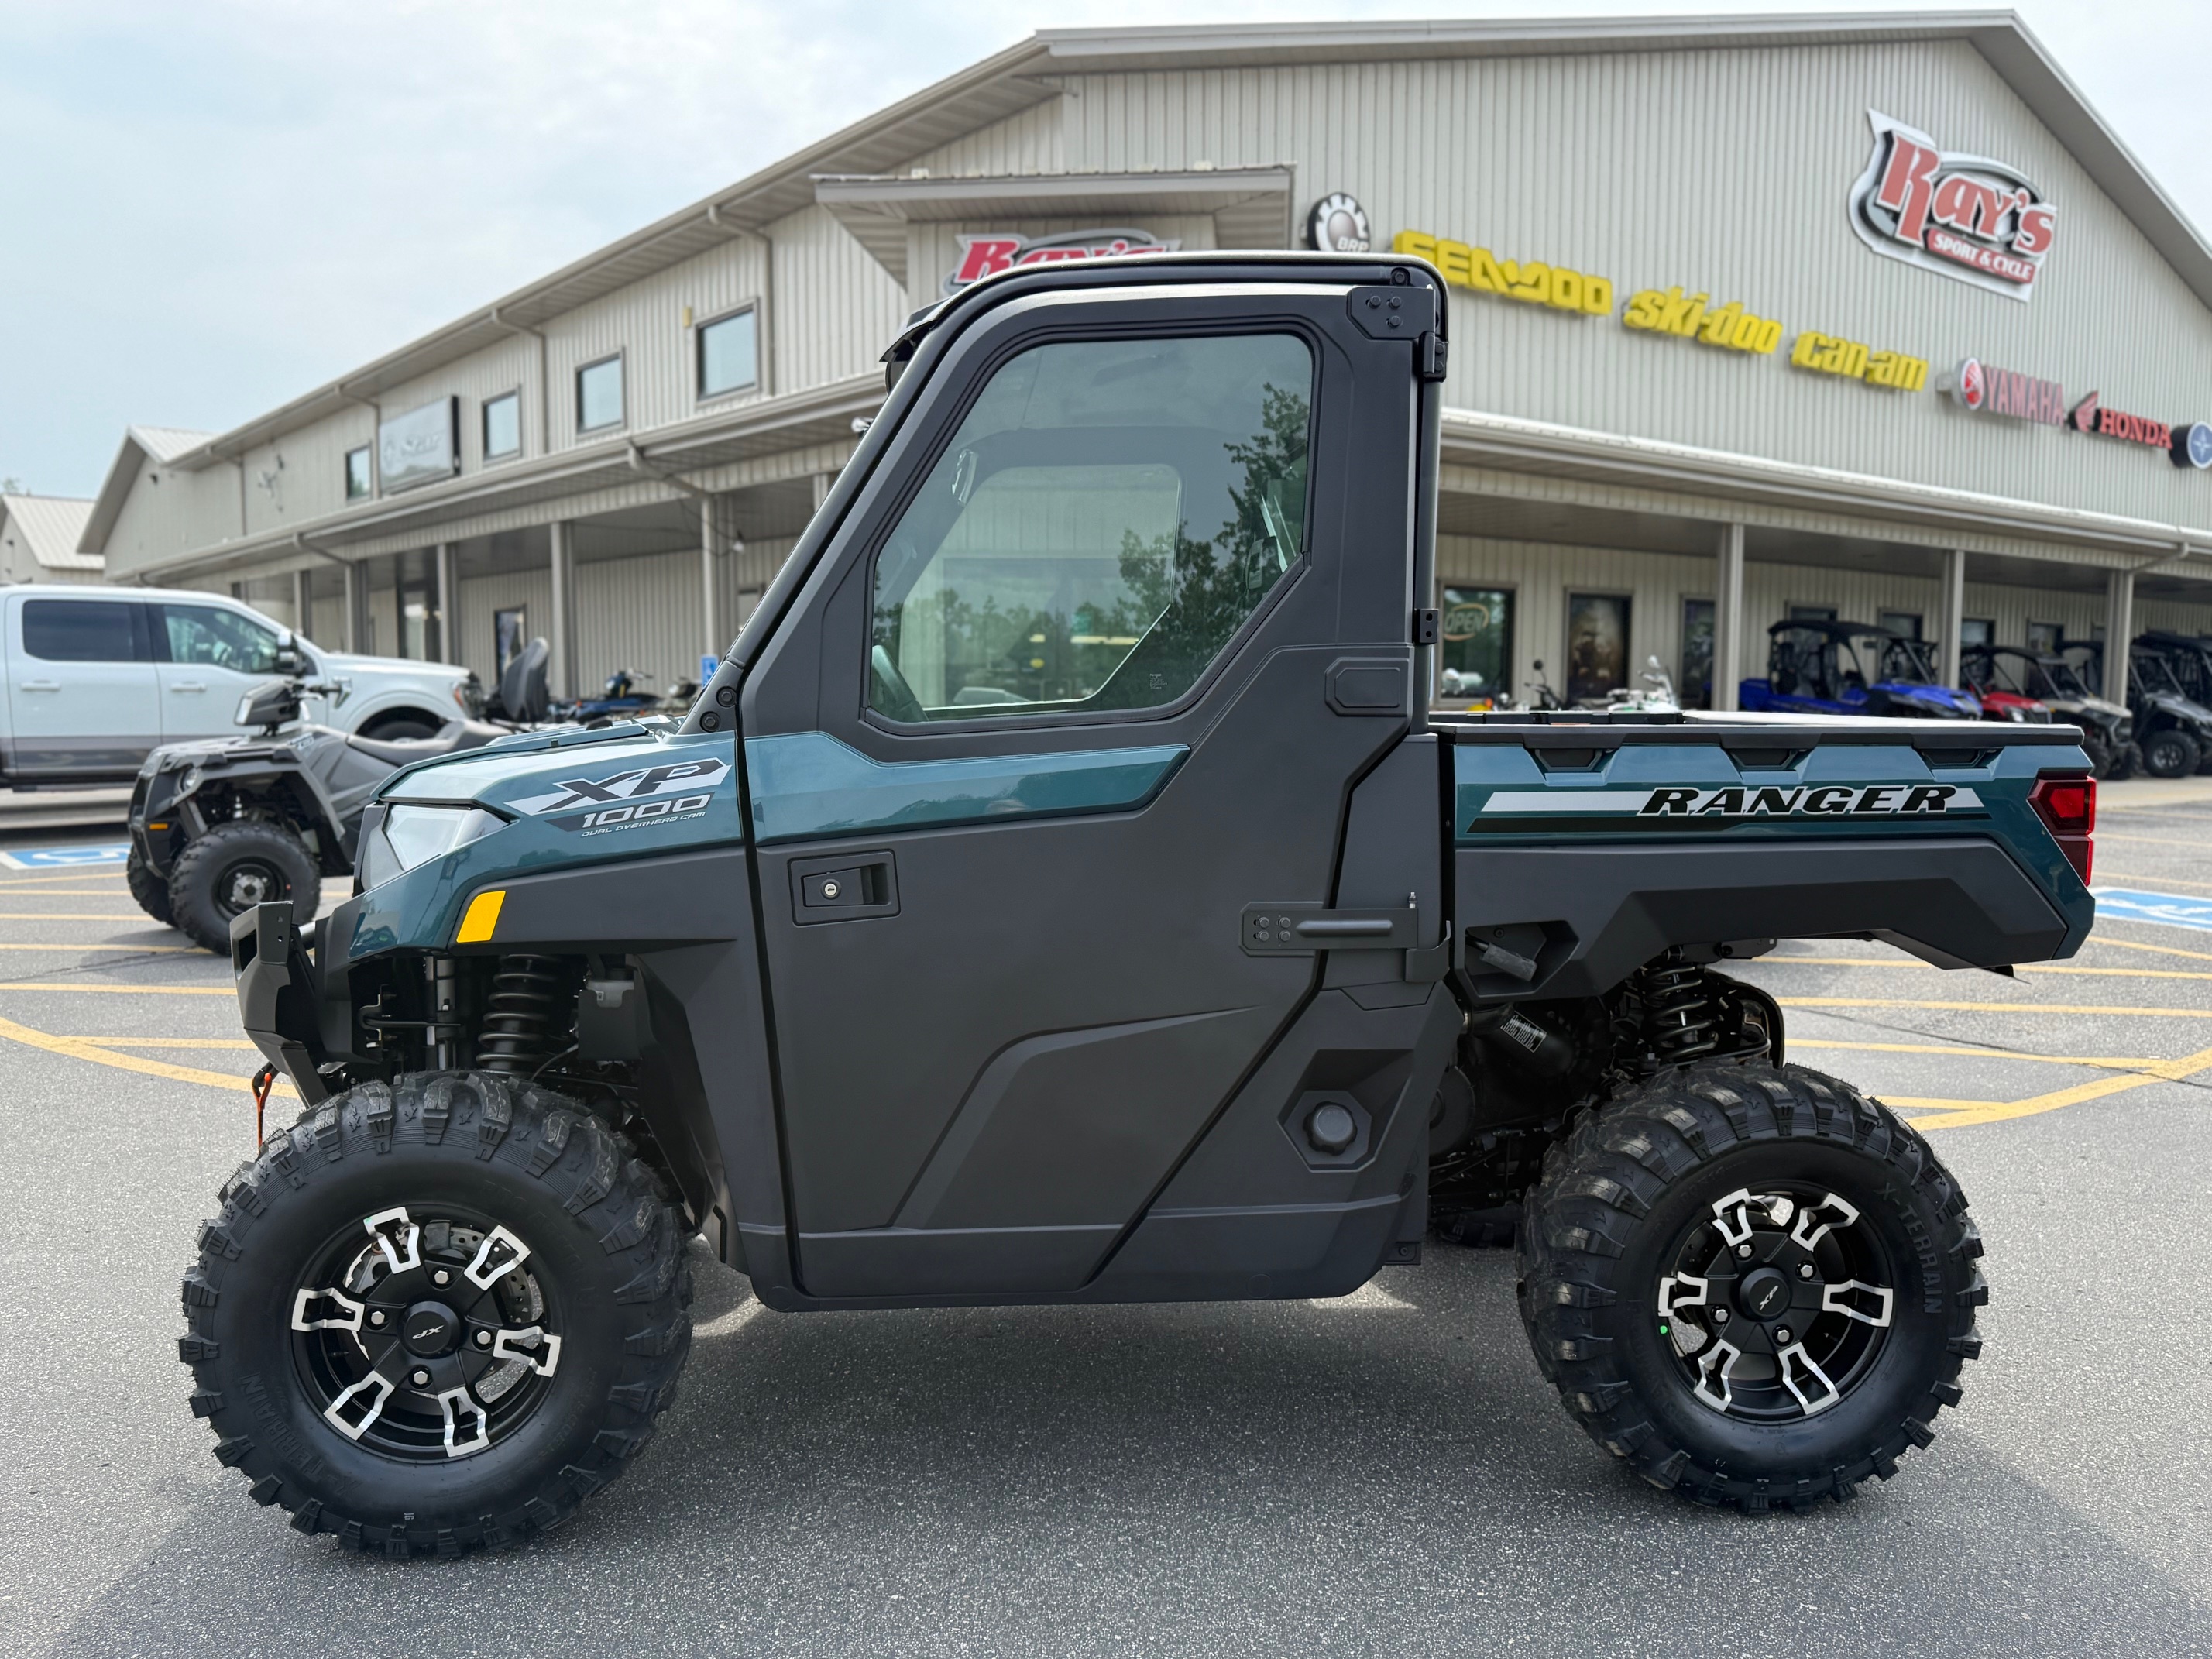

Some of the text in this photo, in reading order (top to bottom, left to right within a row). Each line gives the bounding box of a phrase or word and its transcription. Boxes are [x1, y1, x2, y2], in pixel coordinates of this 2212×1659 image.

[1875, 133, 2056, 256] Ray's
[1933, 232, 2033, 280] SPORT & CYCLE
[1985, 365, 2065, 428] YAMAHA
[2098, 407, 2172, 449] HONDA
[1444, 611, 1484, 633] OPEN
[536, 757, 725, 813] XP
[1637, 785, 1957, 816] RANGER
[581, 811, 706, 837] DUAL OVERHEAD CAM
[582, 794, 711, 828] 1000
[1872, 1181, 1943, 1314] X-TERRAIN
[1759, 1285, 1779, 1310] XP
[412, 1324, 445, 1340] XP
[239, 1372, 363, 1498] X-TERRAIN
